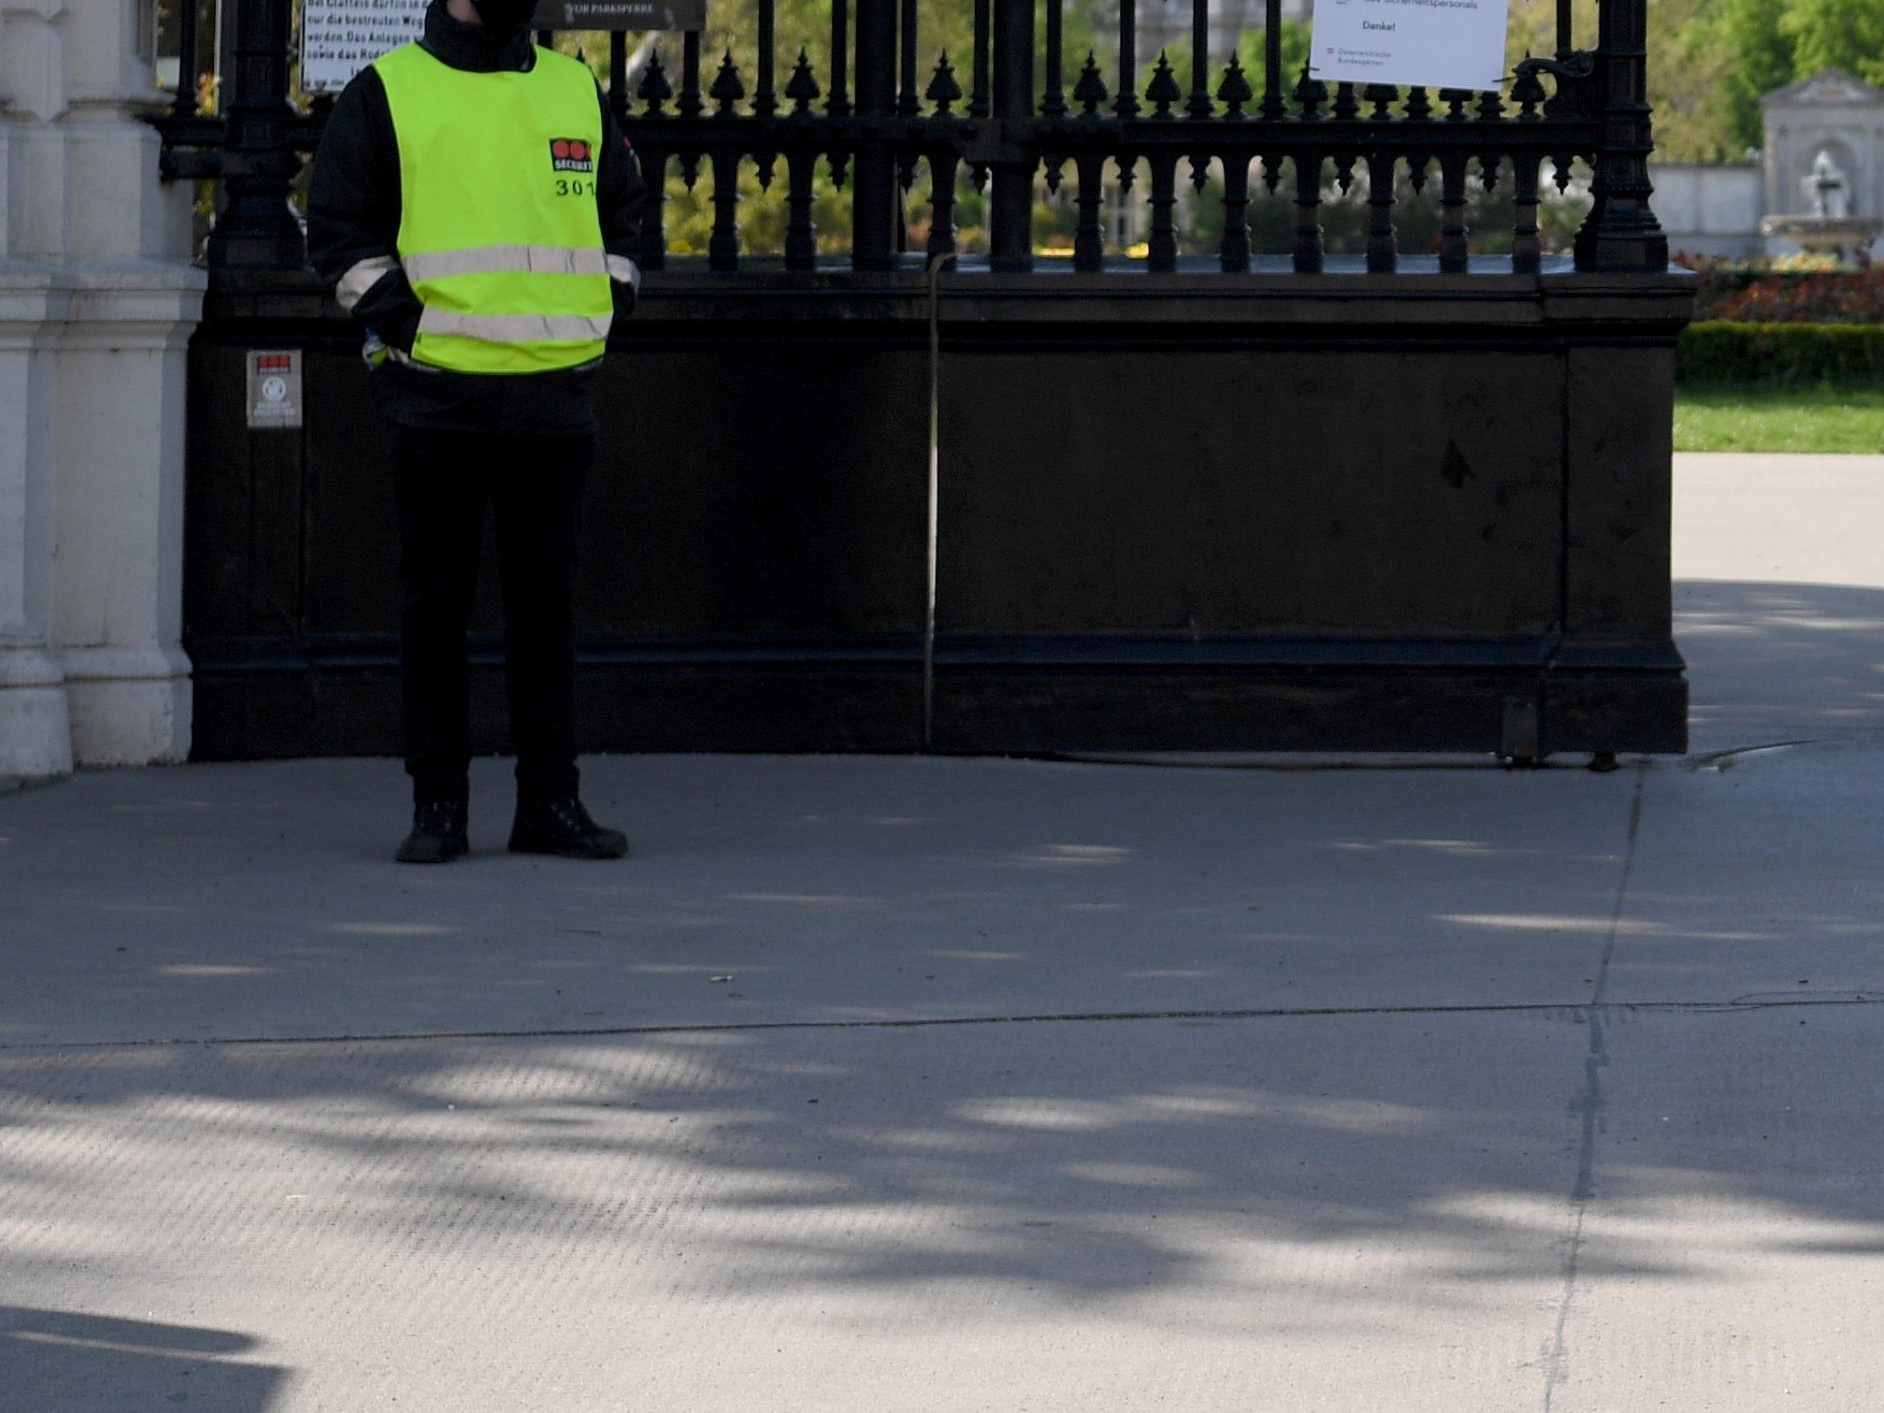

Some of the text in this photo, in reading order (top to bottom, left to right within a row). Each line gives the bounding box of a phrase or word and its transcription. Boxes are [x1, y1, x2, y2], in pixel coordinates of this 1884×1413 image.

[326, 13, 342, 25] die
[403, 15, 424, 29] Weg
[1362, 20, 1396, 32] Danke!
